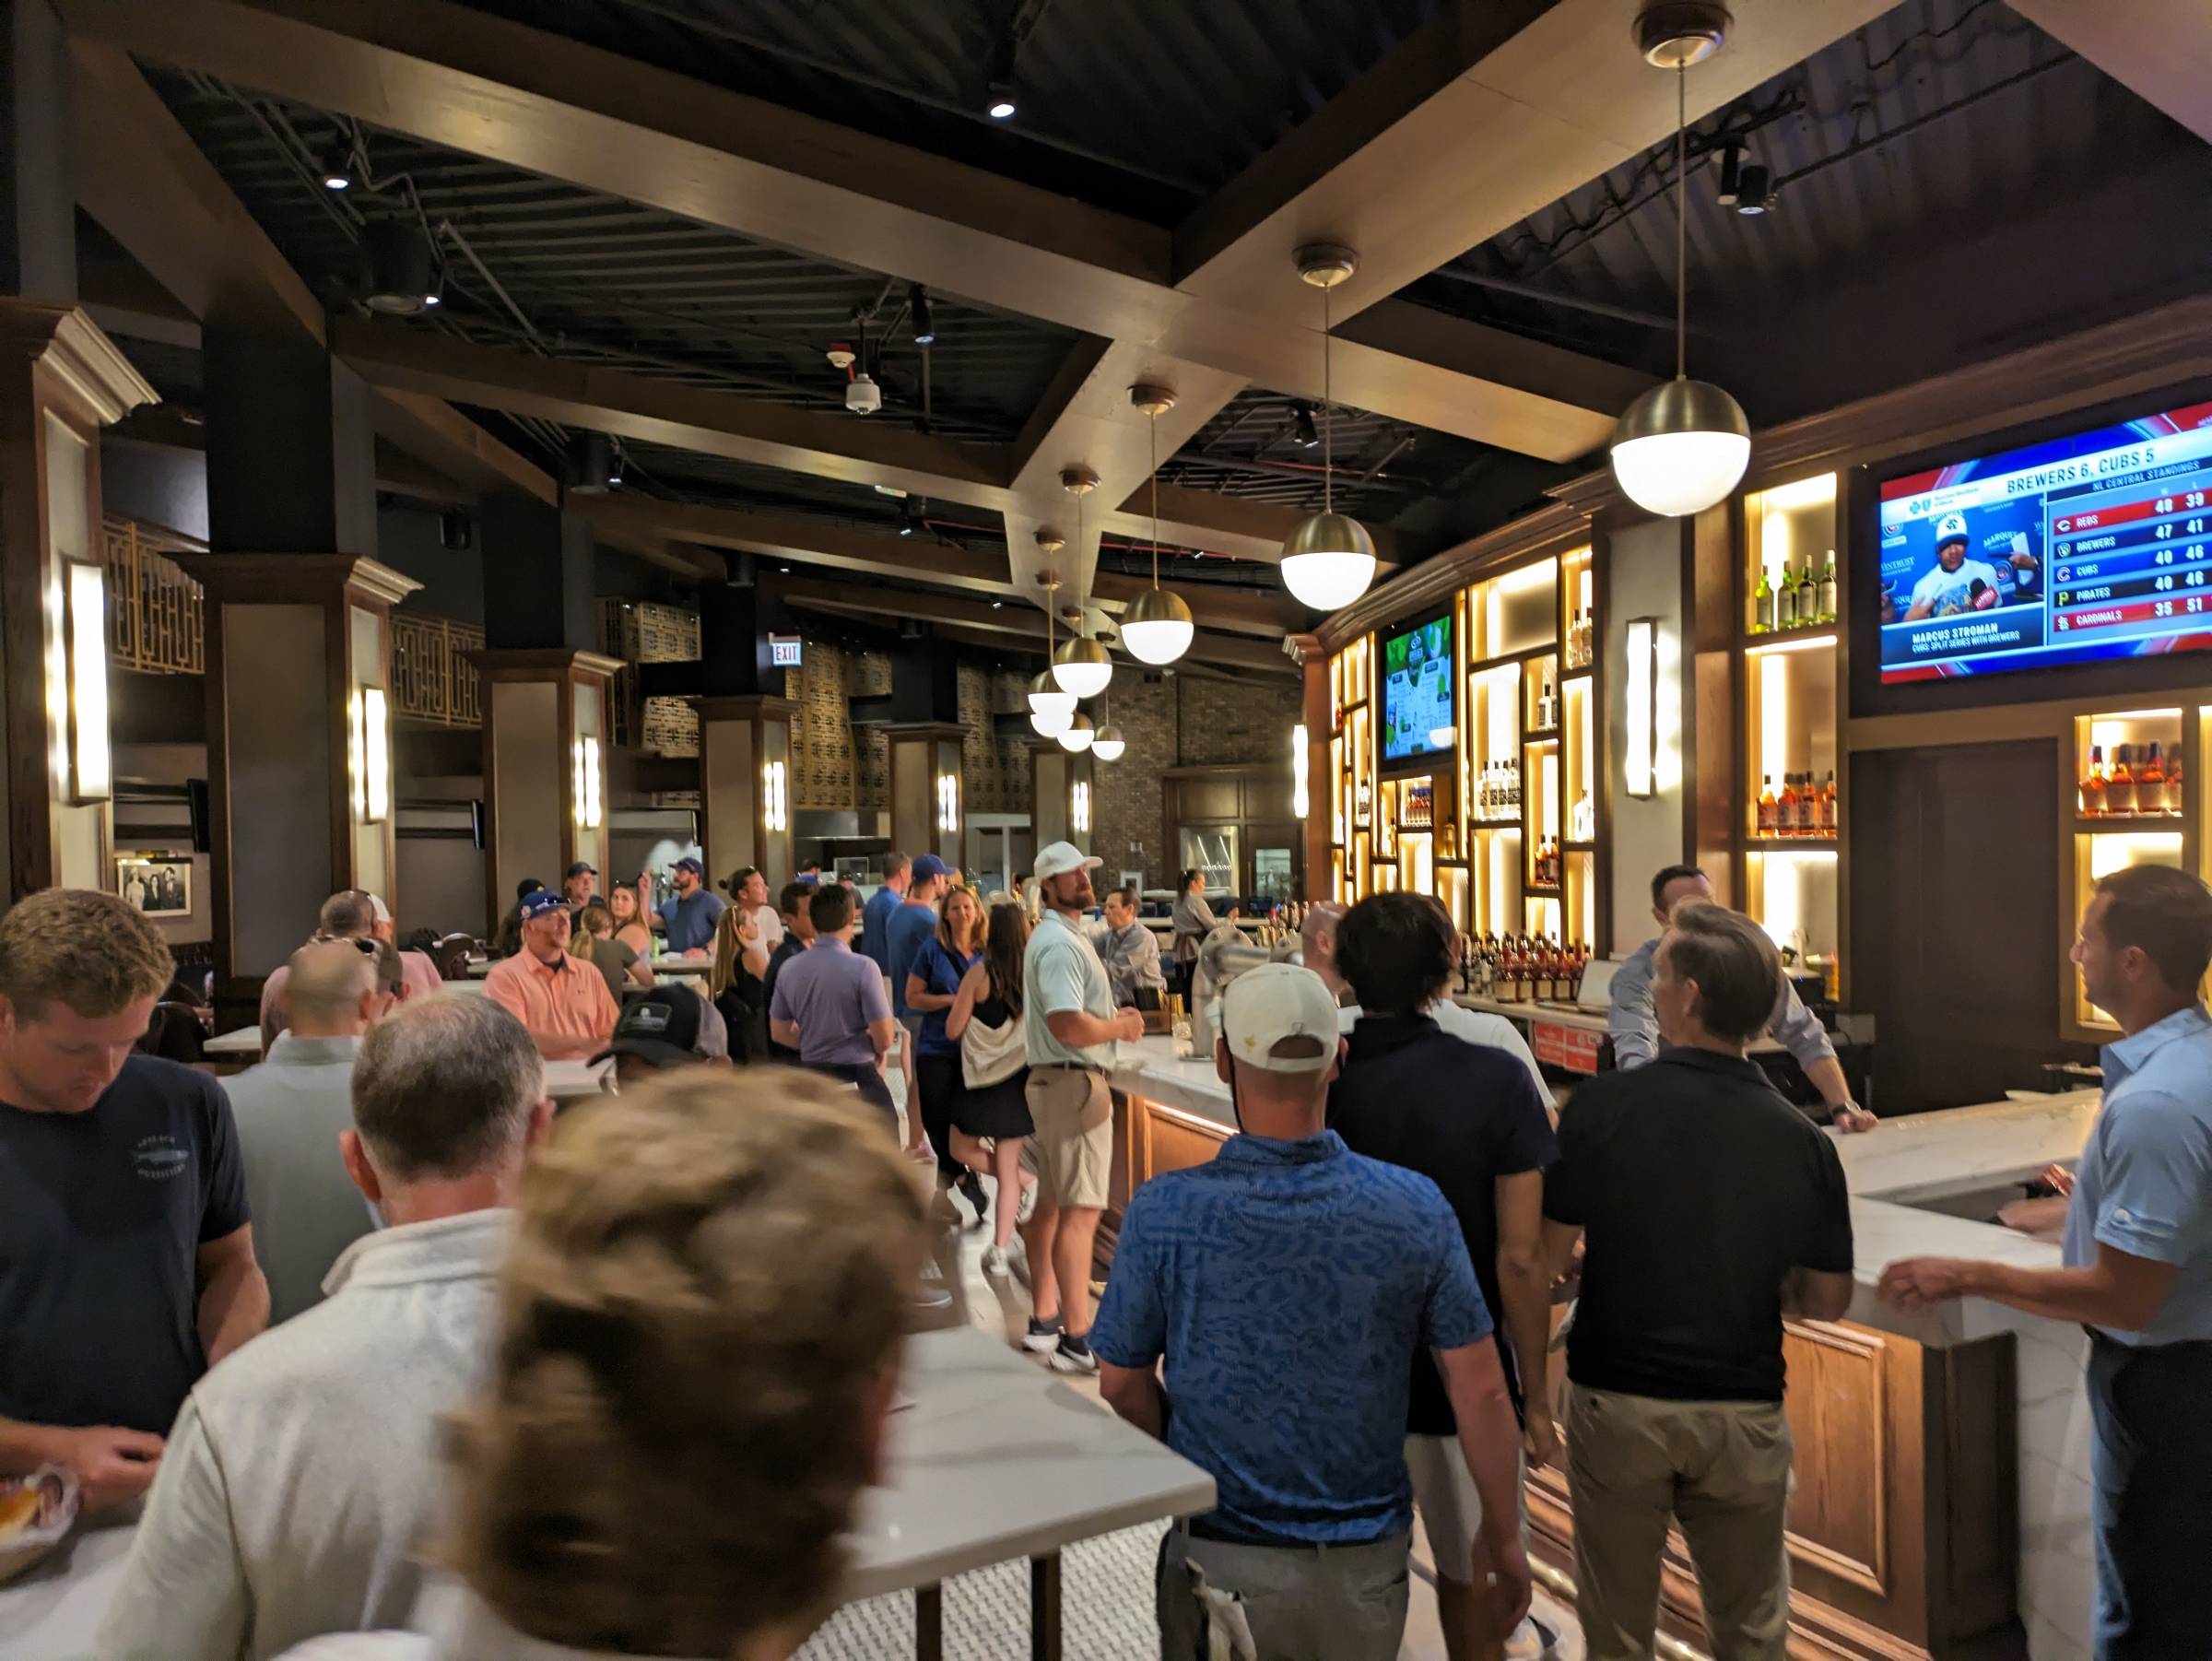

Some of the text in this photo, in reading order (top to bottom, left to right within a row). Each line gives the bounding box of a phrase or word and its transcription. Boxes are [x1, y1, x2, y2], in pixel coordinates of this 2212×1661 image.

[2007, 448, 2155, 493] BREWERS 6, CUBS 5
[2092, 460, 2200, 492] NL CENTRAL STANDINGS
[2077, 514, 2099, 527] REDS
[2155, 499, 2173, 513] 48
[2185, 492, 2204, 508] 39
[2077, 518, 2203, 552] BREWERS 47 41
[2077, 564, 2099, 577] CUBS
[2155, 549, 2173, 565] 40
[2185, 545, 2204, 560] 46
[2077, 586, 2111, 602] PIRATES
[2185, 571, 2204, 586] 46
[2077, 609, 2122, 626] CARDINALS
[2155, 601, 2173, 617] 35
[2186, 597, 2202, 613] 51
[1912, 622, 1998, 644] MARCUS STROMAN
[1930, 639, 1948, 652] SPLIT
[1948, 636, 1971, 649] SERIES
[1971, 634, 1988, 646] WITH
[1988, 630, 2020, 644] BREWERS
[776, 646, 796, 661] EXIT
